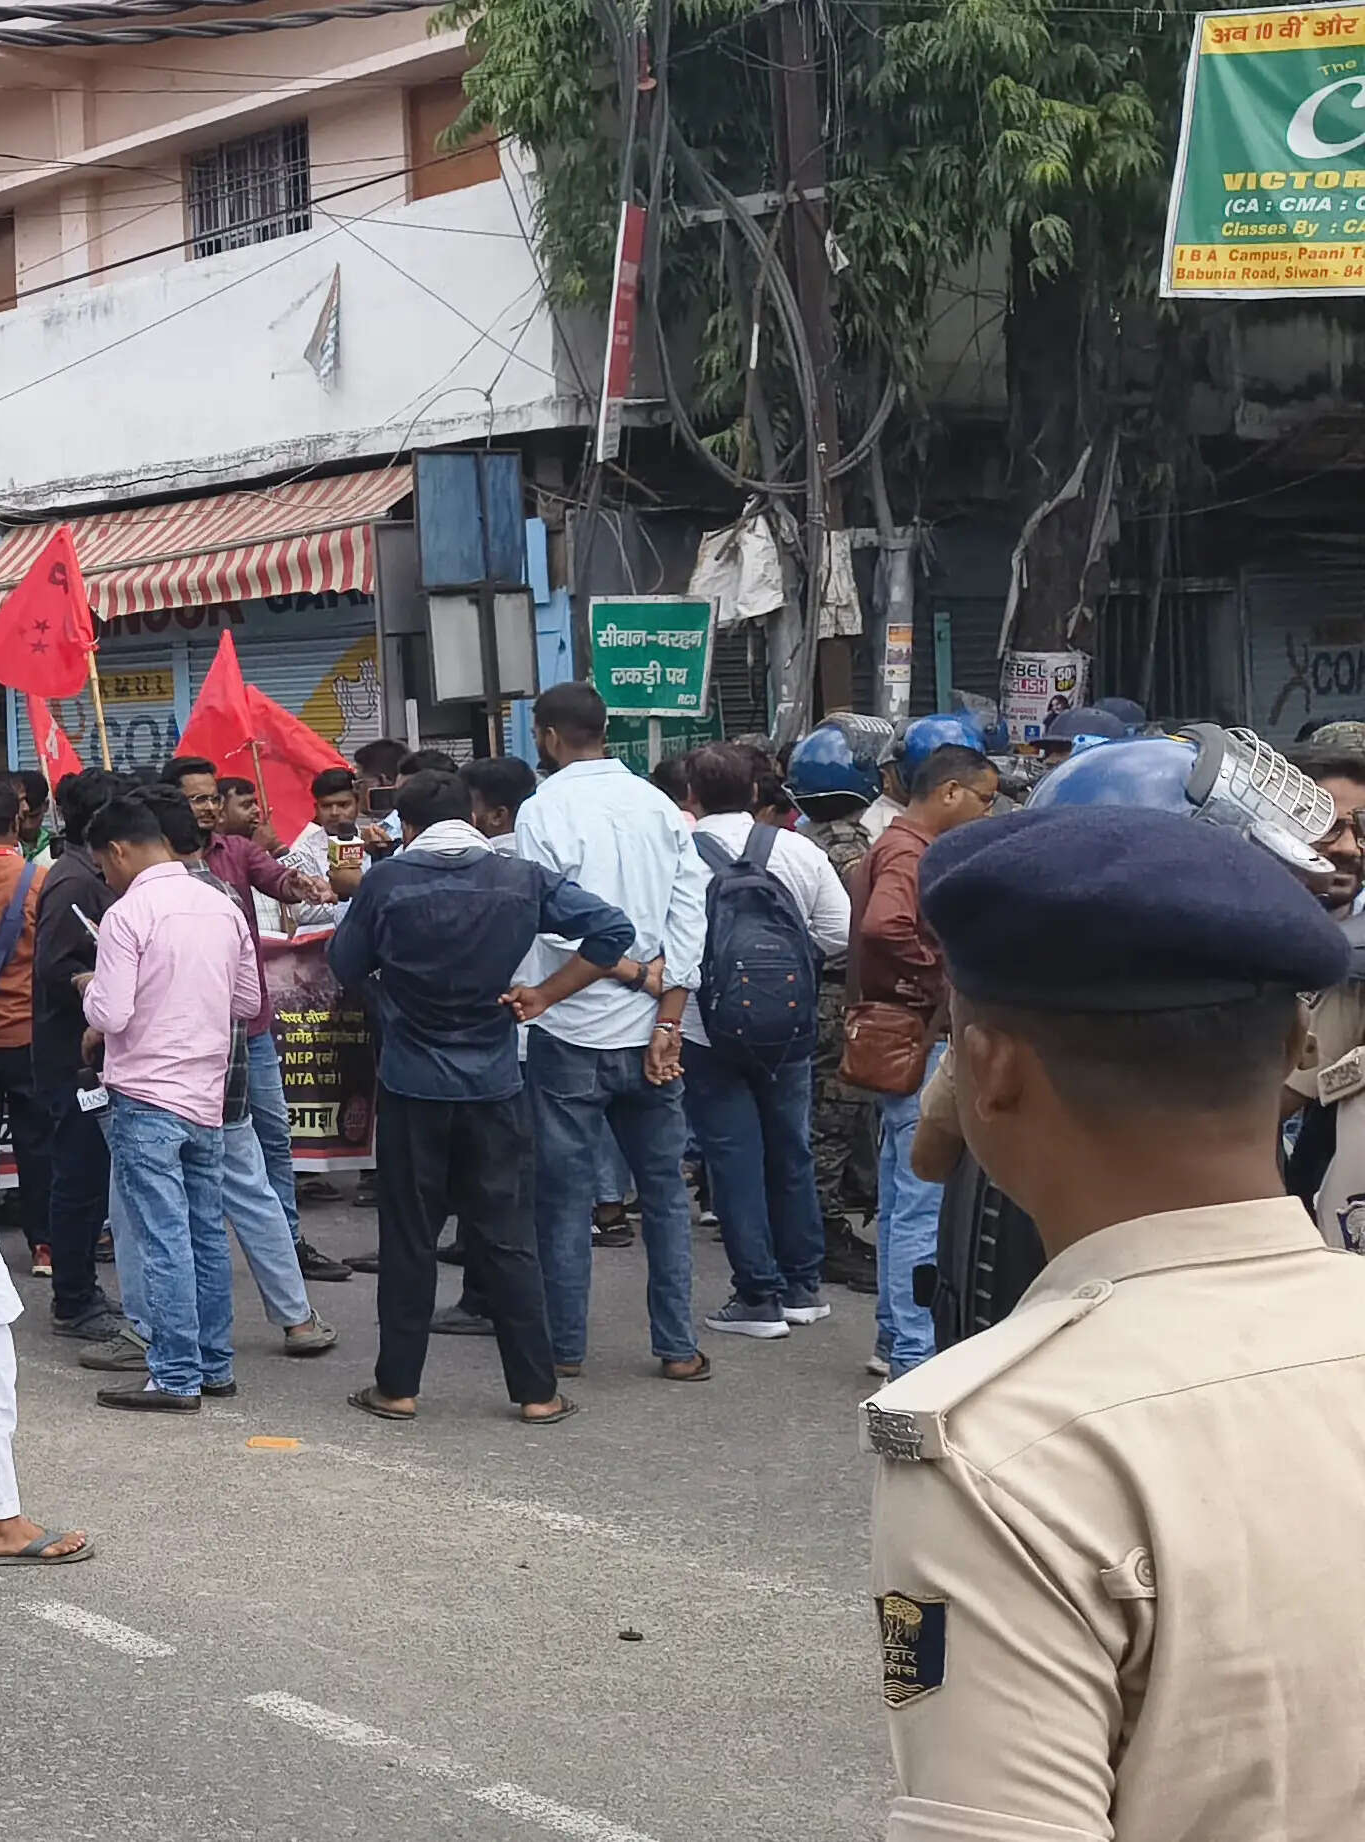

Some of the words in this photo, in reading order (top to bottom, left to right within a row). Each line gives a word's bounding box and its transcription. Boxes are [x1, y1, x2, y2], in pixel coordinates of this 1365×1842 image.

[1211, 25, 1247, 44] अब
[1254, 22, 1273, 41] 10
[1278, 16, 1309, 39] वीं
[1313, 14, 1359, 36] और
[1317, 59, 1357, 77] The
[1279, 197, 1332, 212] CMA
[1221, 221, 1287, 236] Classes
[1292, 220, 1319, 238] By
[1229, 248, 1293, 263] Campus,
[1298, 246, 1345, 260] Paani
[1351, 246, 1365, 259] T
[1176, 267, 1237, 280] Babunia
[1241, 266, 1280, 281] Road,
[1284, 266, 1329, 279] Siwan
[610, 660, 663, 694] लकड़ी
[285, 1052, 314, 1065] NEP
[284, 1072, 315, 1086] NTA
[81, 1091, 108, 1107] IANS
